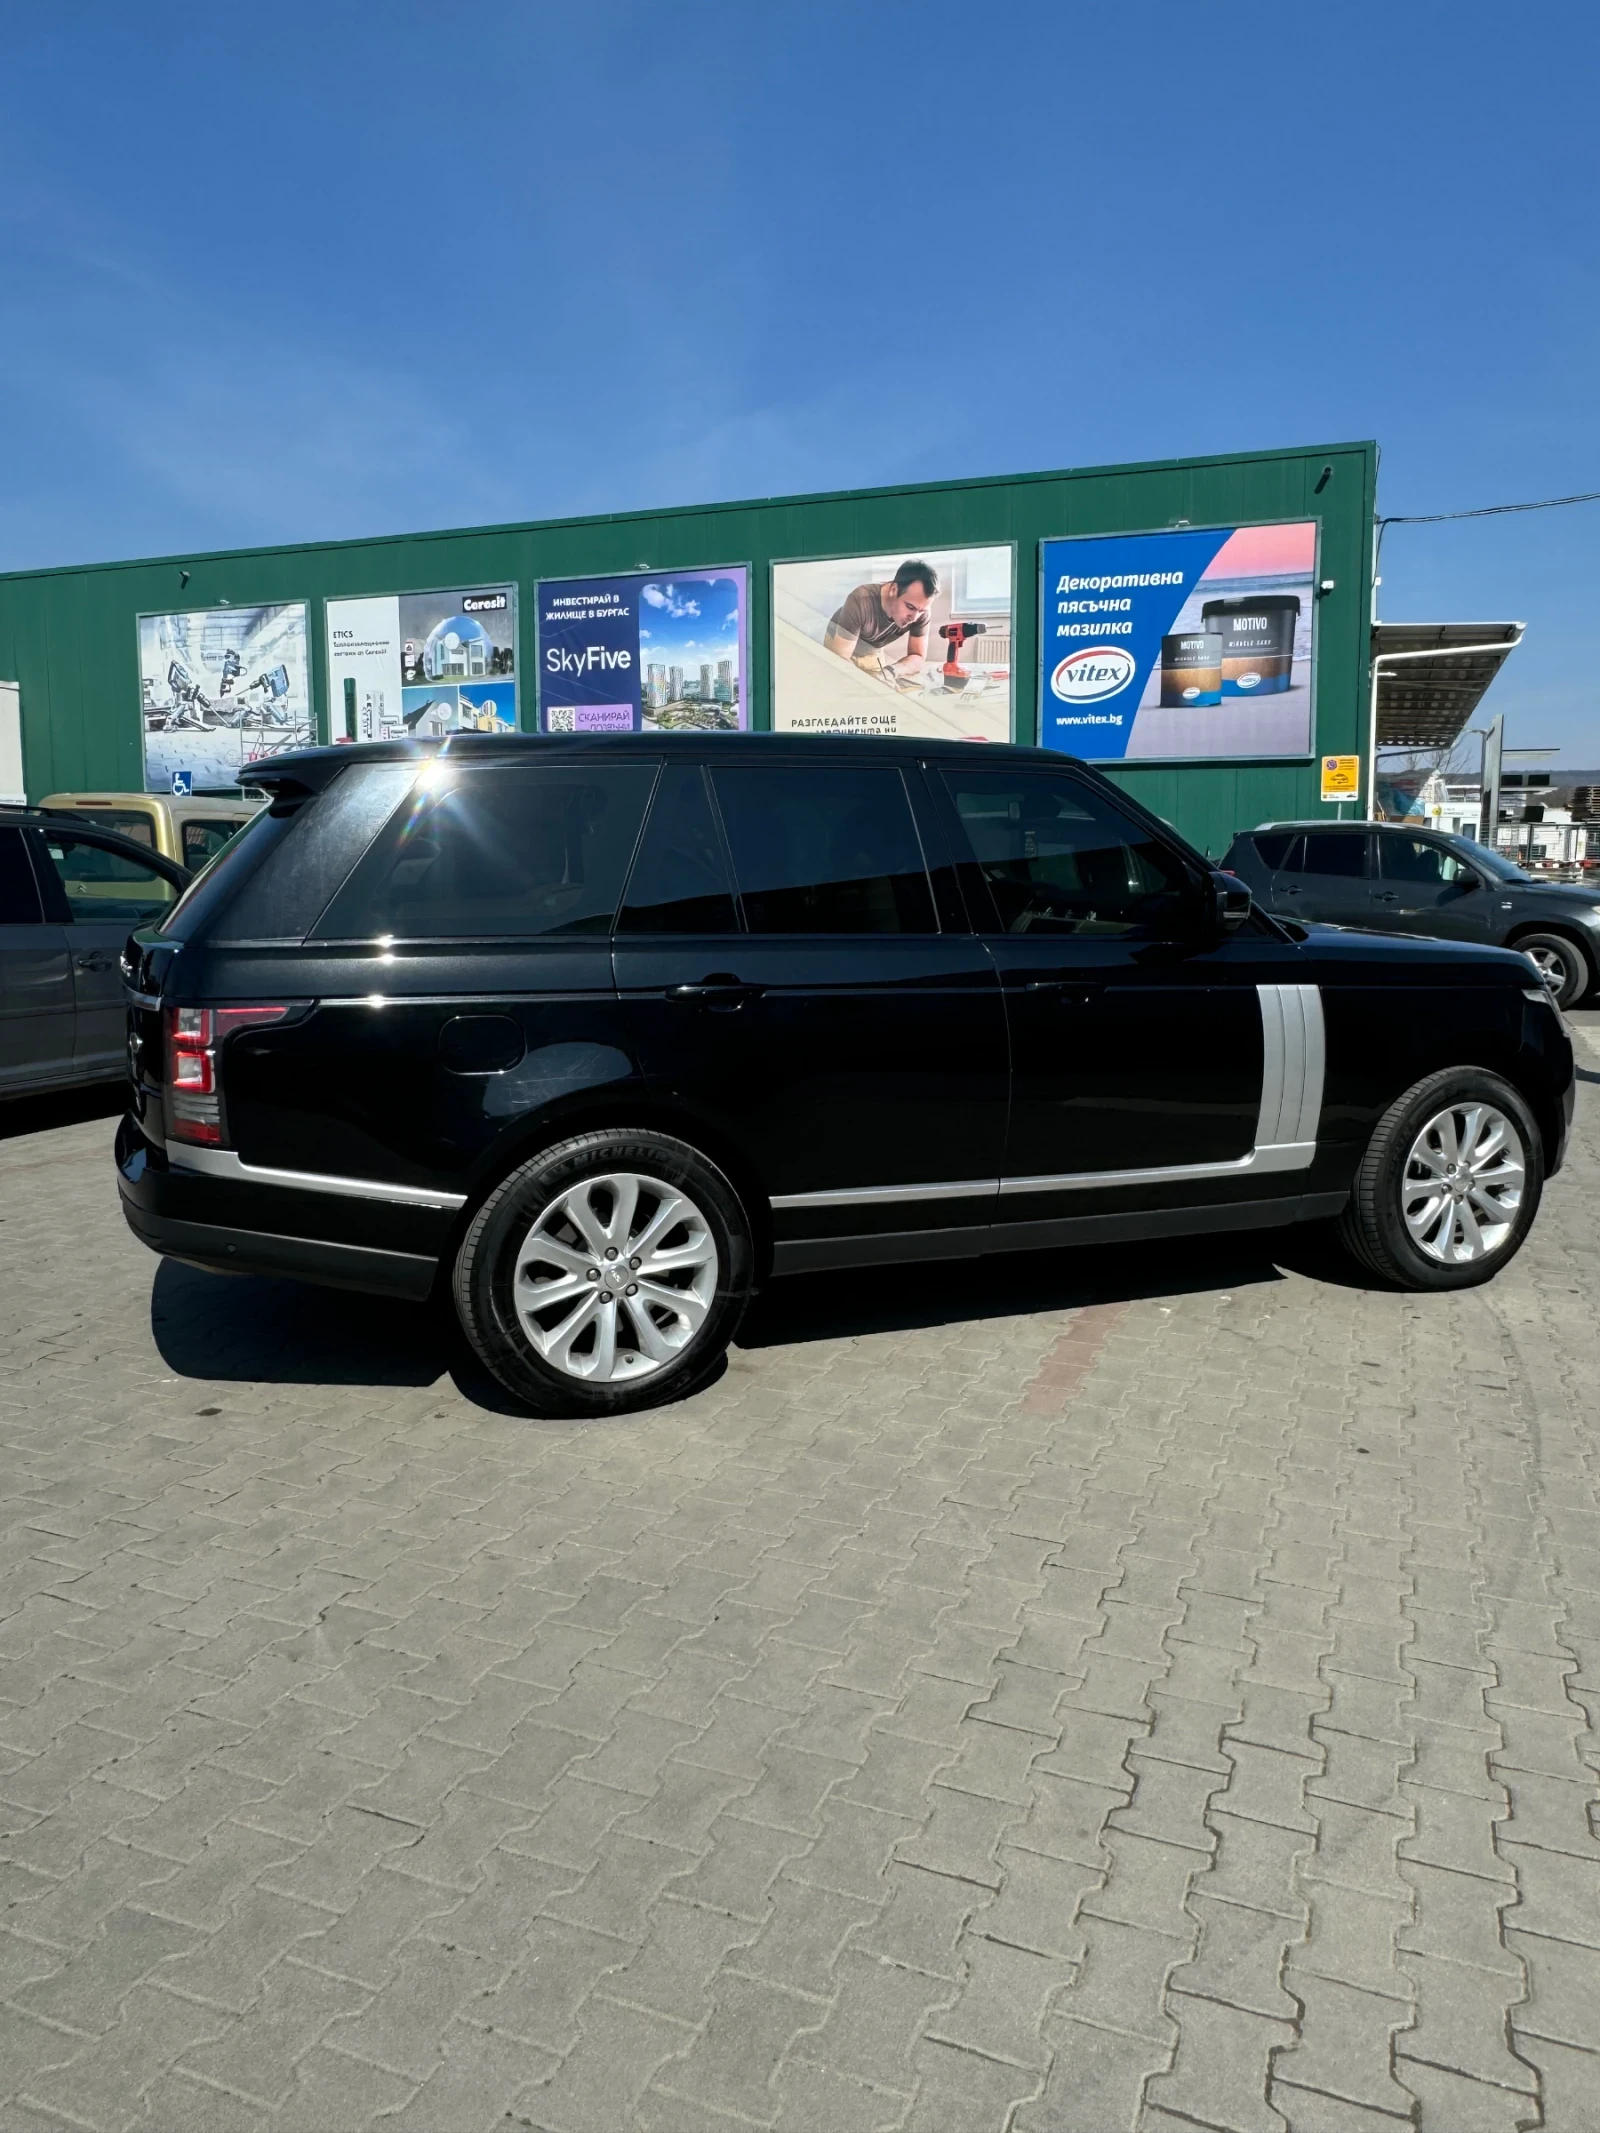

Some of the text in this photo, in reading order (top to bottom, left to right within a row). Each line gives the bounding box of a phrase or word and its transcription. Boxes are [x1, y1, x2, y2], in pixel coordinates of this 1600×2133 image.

[1056, 571, 1184, 594] Декоративна
[463, 595, 506, 611] Ceresit
[553, 593, 620, 606] ИНВЕСТИРАЙ В
[1057, 598, 1132, 614] пясъчна
[545, 607, 630, 620] ЖИЛИЩЕ В БУРГАС
[1057, 621, 1133, 637] мазилка
[1233, 617, 1268, 631] MOTIVO
[1180, 640, 1205, 650] MOTIVO
[546, 645, 631, 677] SkyFive
[1067, 663, 1122, 682] vitex
[578, 710, 630, 723] СКАНИРАЙ
[791, 715, 897, 728] РАЗГЛЕДАЙТЕ ОЩЕ
[1056, 713, 1123, 725] www.vitex.bg
